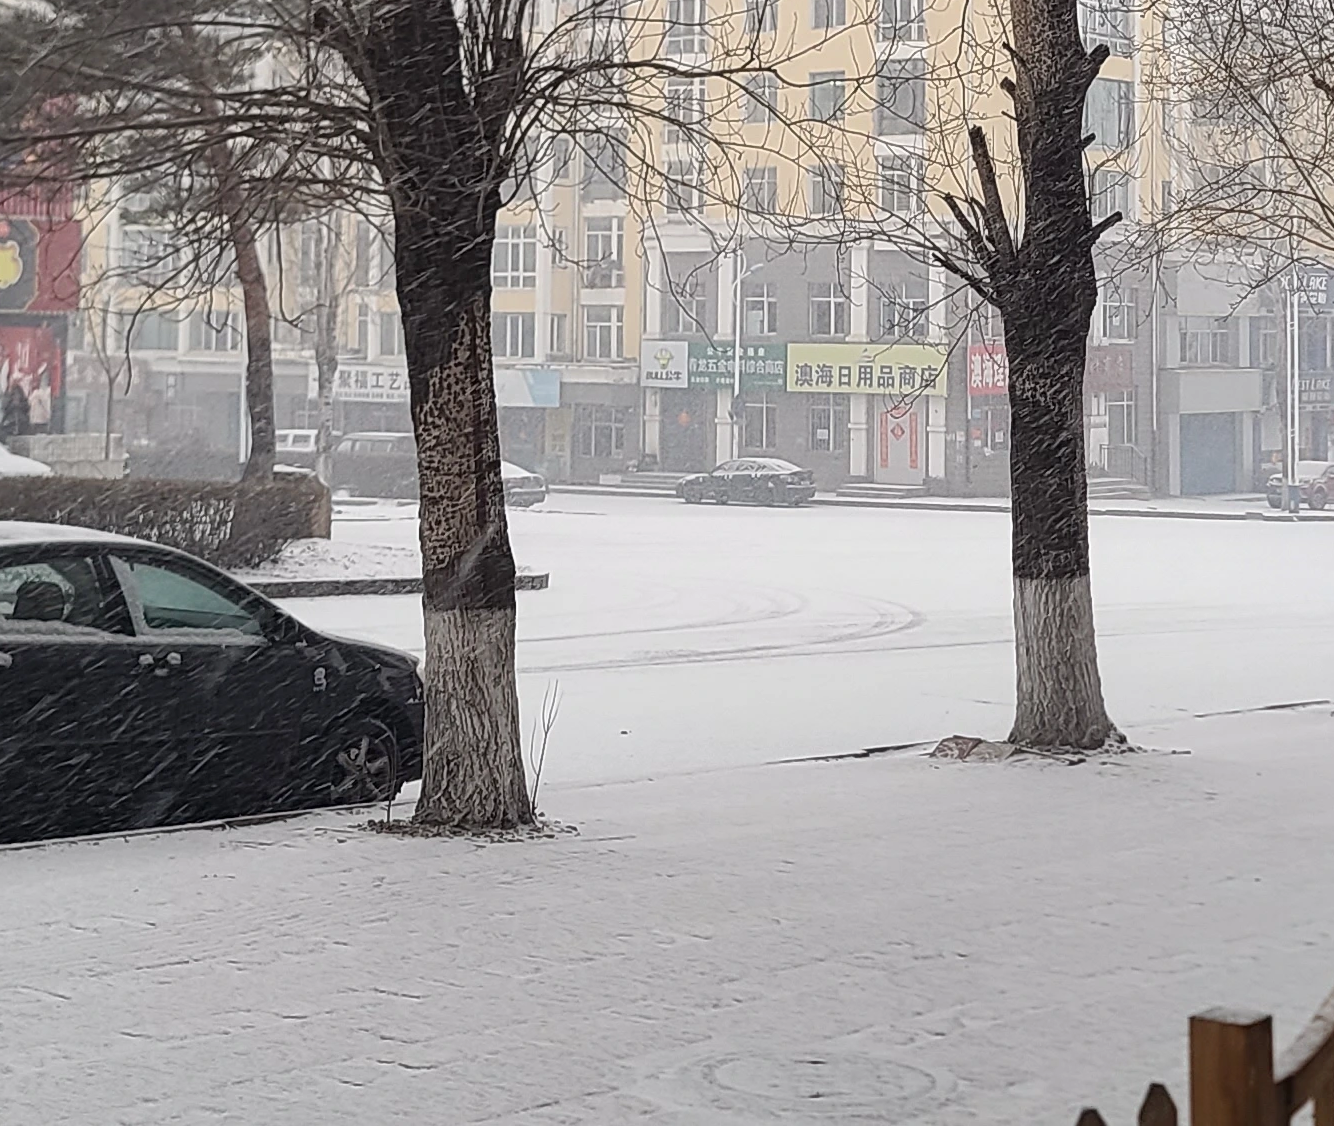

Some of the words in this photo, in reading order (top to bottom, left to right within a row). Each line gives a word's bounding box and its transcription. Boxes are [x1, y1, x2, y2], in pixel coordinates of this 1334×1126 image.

[794, 362, 939, 390] 澳海日用品商店
